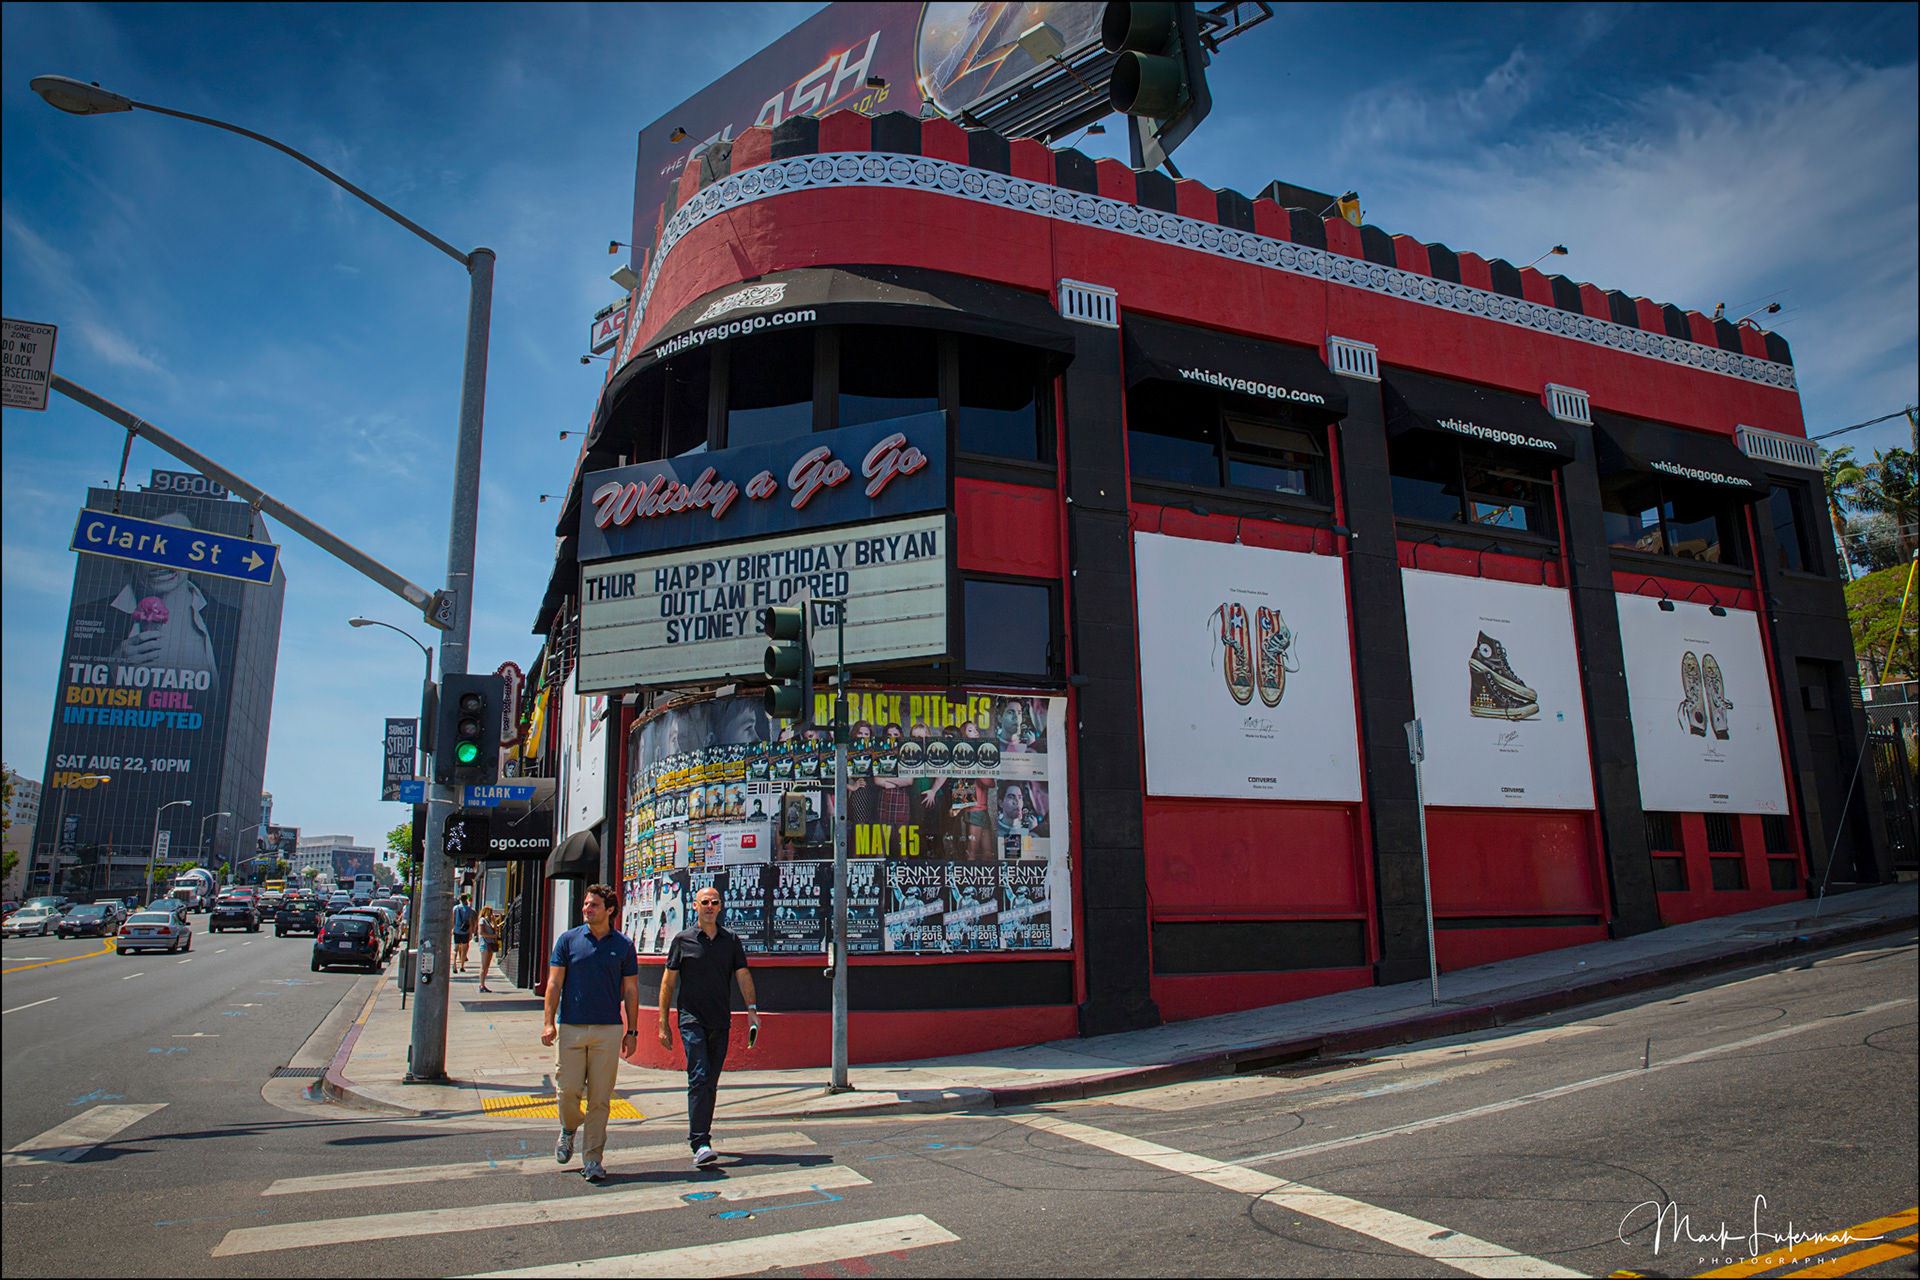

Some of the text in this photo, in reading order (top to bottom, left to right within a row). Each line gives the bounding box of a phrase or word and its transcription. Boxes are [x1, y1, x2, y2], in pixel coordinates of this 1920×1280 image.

[660, 155, 685, 176] THE
[11, 331, 31, 340] ZONE
[655, 309, 817, 359] whiskyagogo.com
[2, 340, 37, 354] DO NOT
[3, 353, 32, 367] BLOCK
[1179, 368, 1325, 404] whiskyagogo.com
[1437, 418, 1557, 450] whiskyagogo.com
[592, 432, 928, 529] Whisky a Go Go
[1650, 461, 1752, 487] whiskyagogo.com
[154, 472, 224, 497] 9000
[86, 522, 222, 564] Clark St
[585, 531, 937, 601] THUR HAPPY BIRTHDAY BRYAN
[661, 570, 849, 617] OUTLAW FLOORED
[75, 619, 103, 627] COMEDY
[666, 611, 750, 644] SYDNEY
[69, 663, 211, 691] TIG NOTARO
[66, 686, 193, 709] BOYISH GIRL
[63, 706, 203, 730] INTERRUPTED
[848, 692, 901, 728] BACK
[388, 725, 414, 735] SUNSET
[387, 736, 414, 755] STRIP
[56, 754, 191, 773] SAT AUG 22, 10PM
[388, 757, 412, 774] WEST
[52, 771, 99, 789] HBO
[474, 786, 511, 798] CLARK
[855, 824, 920, 856] MAY 15
[729, 866, 760, 877] THE MAIN
[779, 865, 815, 875] THE MAIN
[853, 865, 875, 875] MAIN
[886, 865, 941, 877] LENNY
[944, 865, 995, 877] LENNY
[998, 865, 1048, 877] LENNY
[729, 876, 760, 889] EVENT
[779, 875, 815, 888] EVENT
[886, 876, 941, 885] KRAVITZ
[944, 876, 995, 885] KRAVITZ
[886, 903, 943, 923] SOLD OUT
[944, 903, 997, 923] SOLD OUT
[999, 902, 1050, 922] SOLD OUT
[910, 932, 918, 941] 15
[922, 932, 942, 941] 2015
[967, 932, 975, 941] 15
[978, 932, 998, 941] 2015
[1021, 931, 1029, 939] 15
[1031, 930, 1051, 939] 2015
